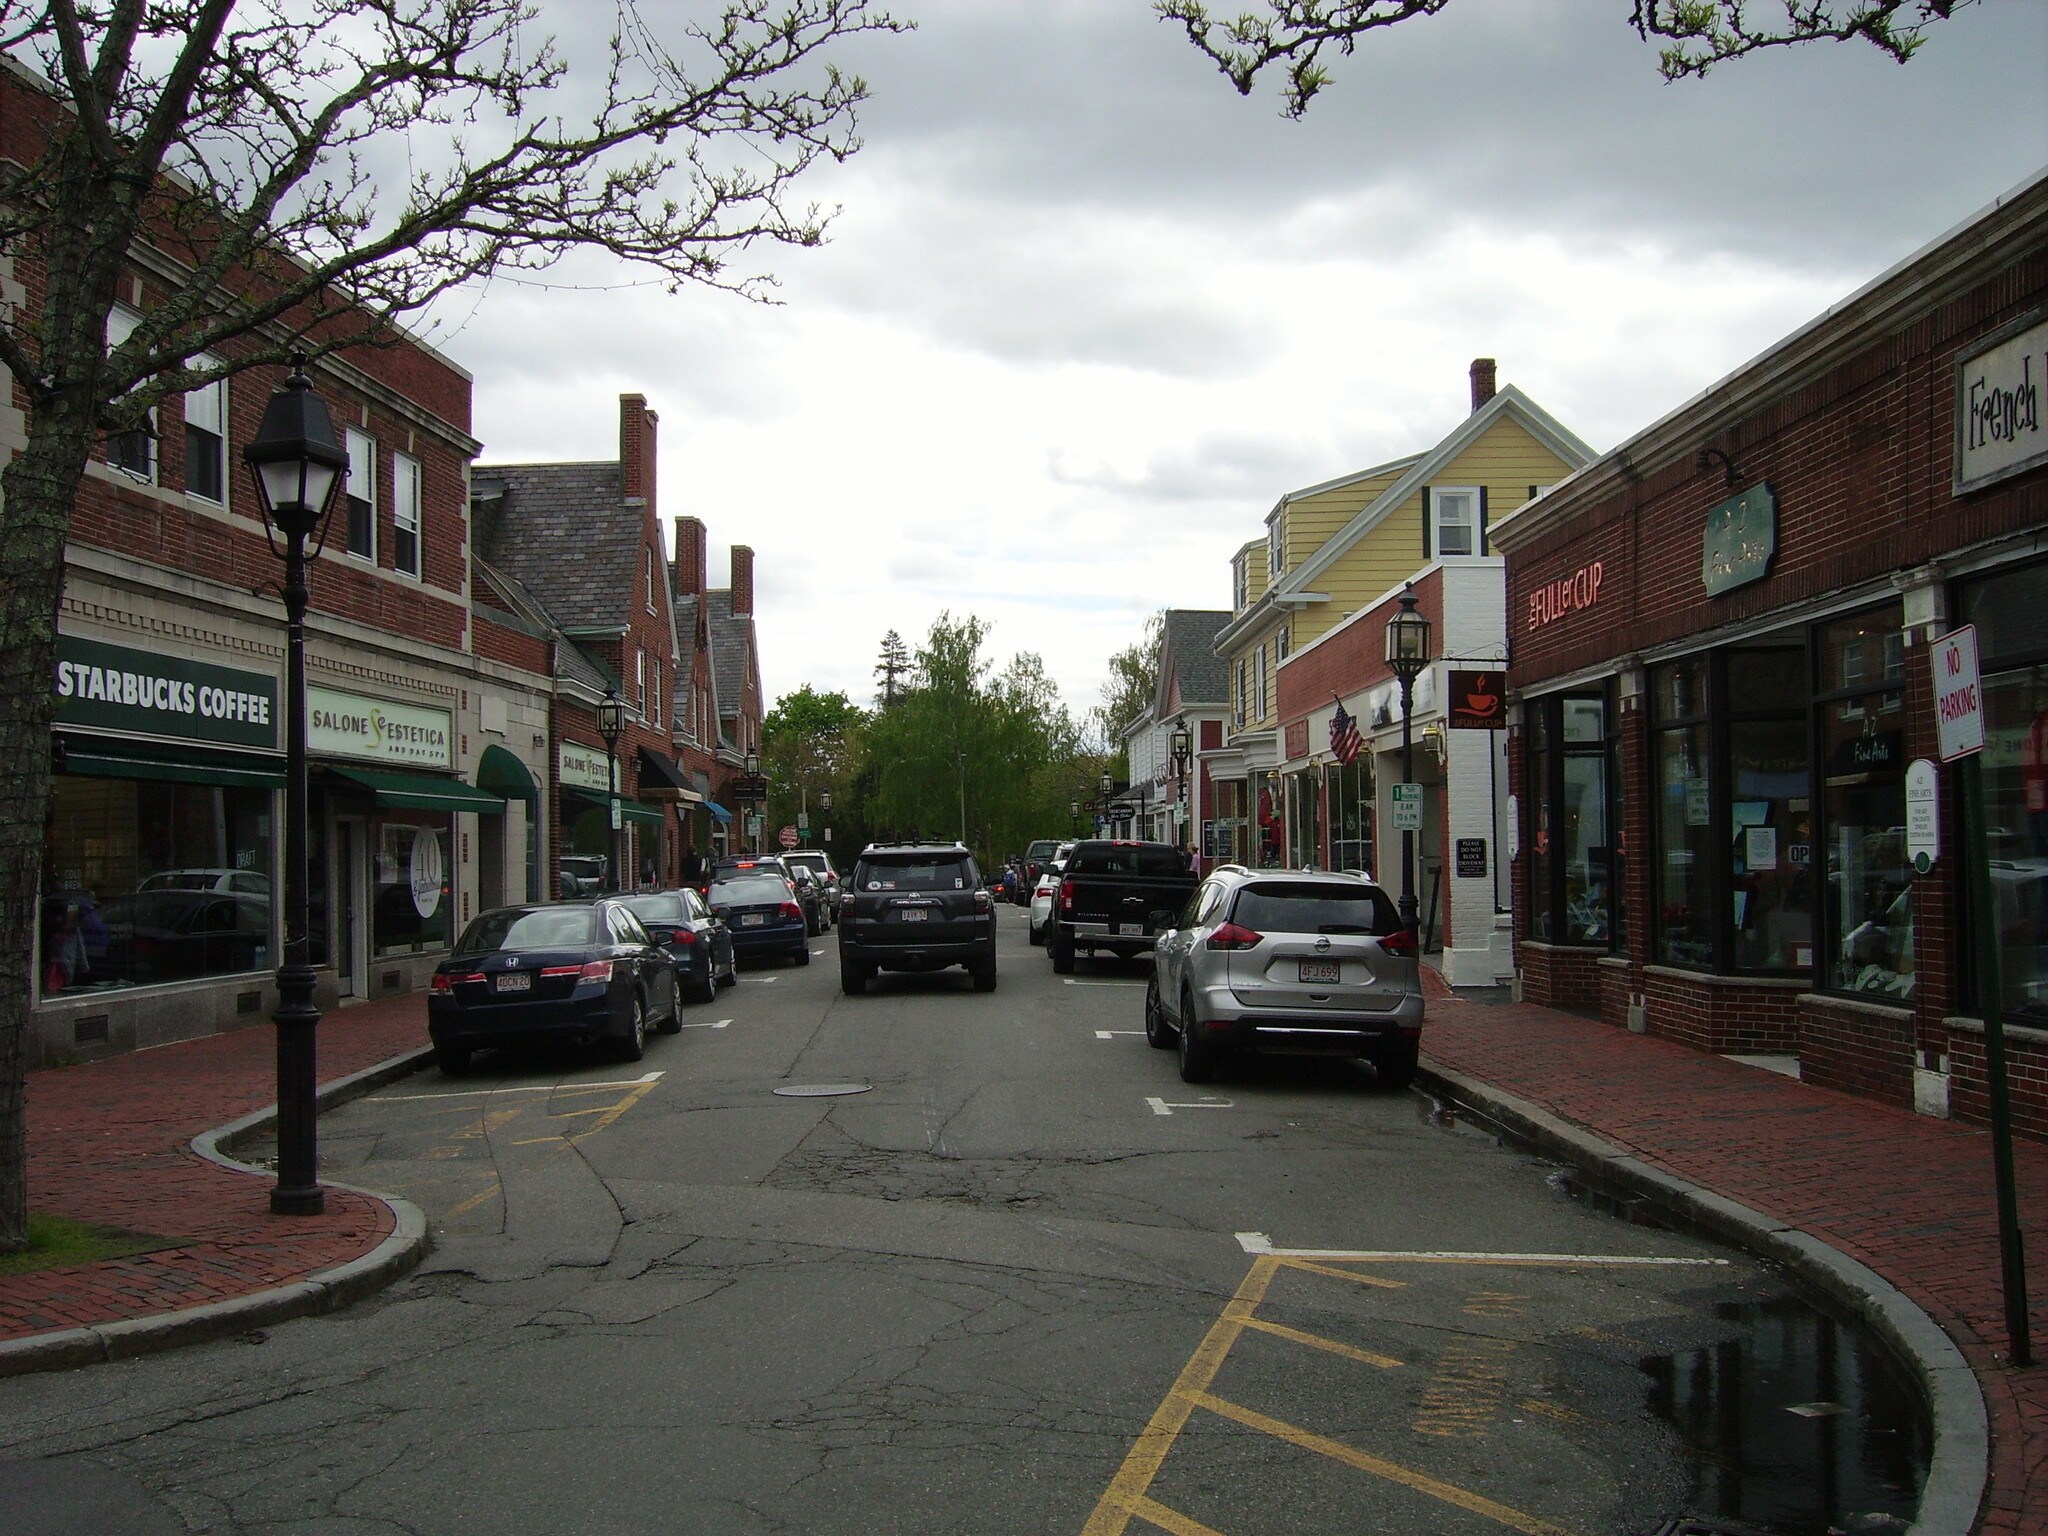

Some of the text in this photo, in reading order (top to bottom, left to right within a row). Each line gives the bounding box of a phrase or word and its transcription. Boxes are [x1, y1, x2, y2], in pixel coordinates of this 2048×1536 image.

[1968, 355, 2038, 451] French
[1574, 562, 1602, 610] CUP
[1946, 646, 1960, 677] NO
[58, 660, 269, 725] STARBUCKS COFFEE
[1940, 683, 1976, 724] PARKING
[313, 709, 368, 737] SALONE
[387, 723, 445, 746] ESTETICA
[388, 745, 445, 759] AND DAY SPA
[1854, 740, 1889, 763] Fine Arts
[563, 755, 586, 773] SALONE
[592, 763, 608, 778] ESTET
[1908, 789, 1932, 799] FINE ARTS
[236, 849, 256, 868] DRAFT
[1790, 847, 1808, 861] OP
[1302, 966, 1338, 977] 4FJ 699
